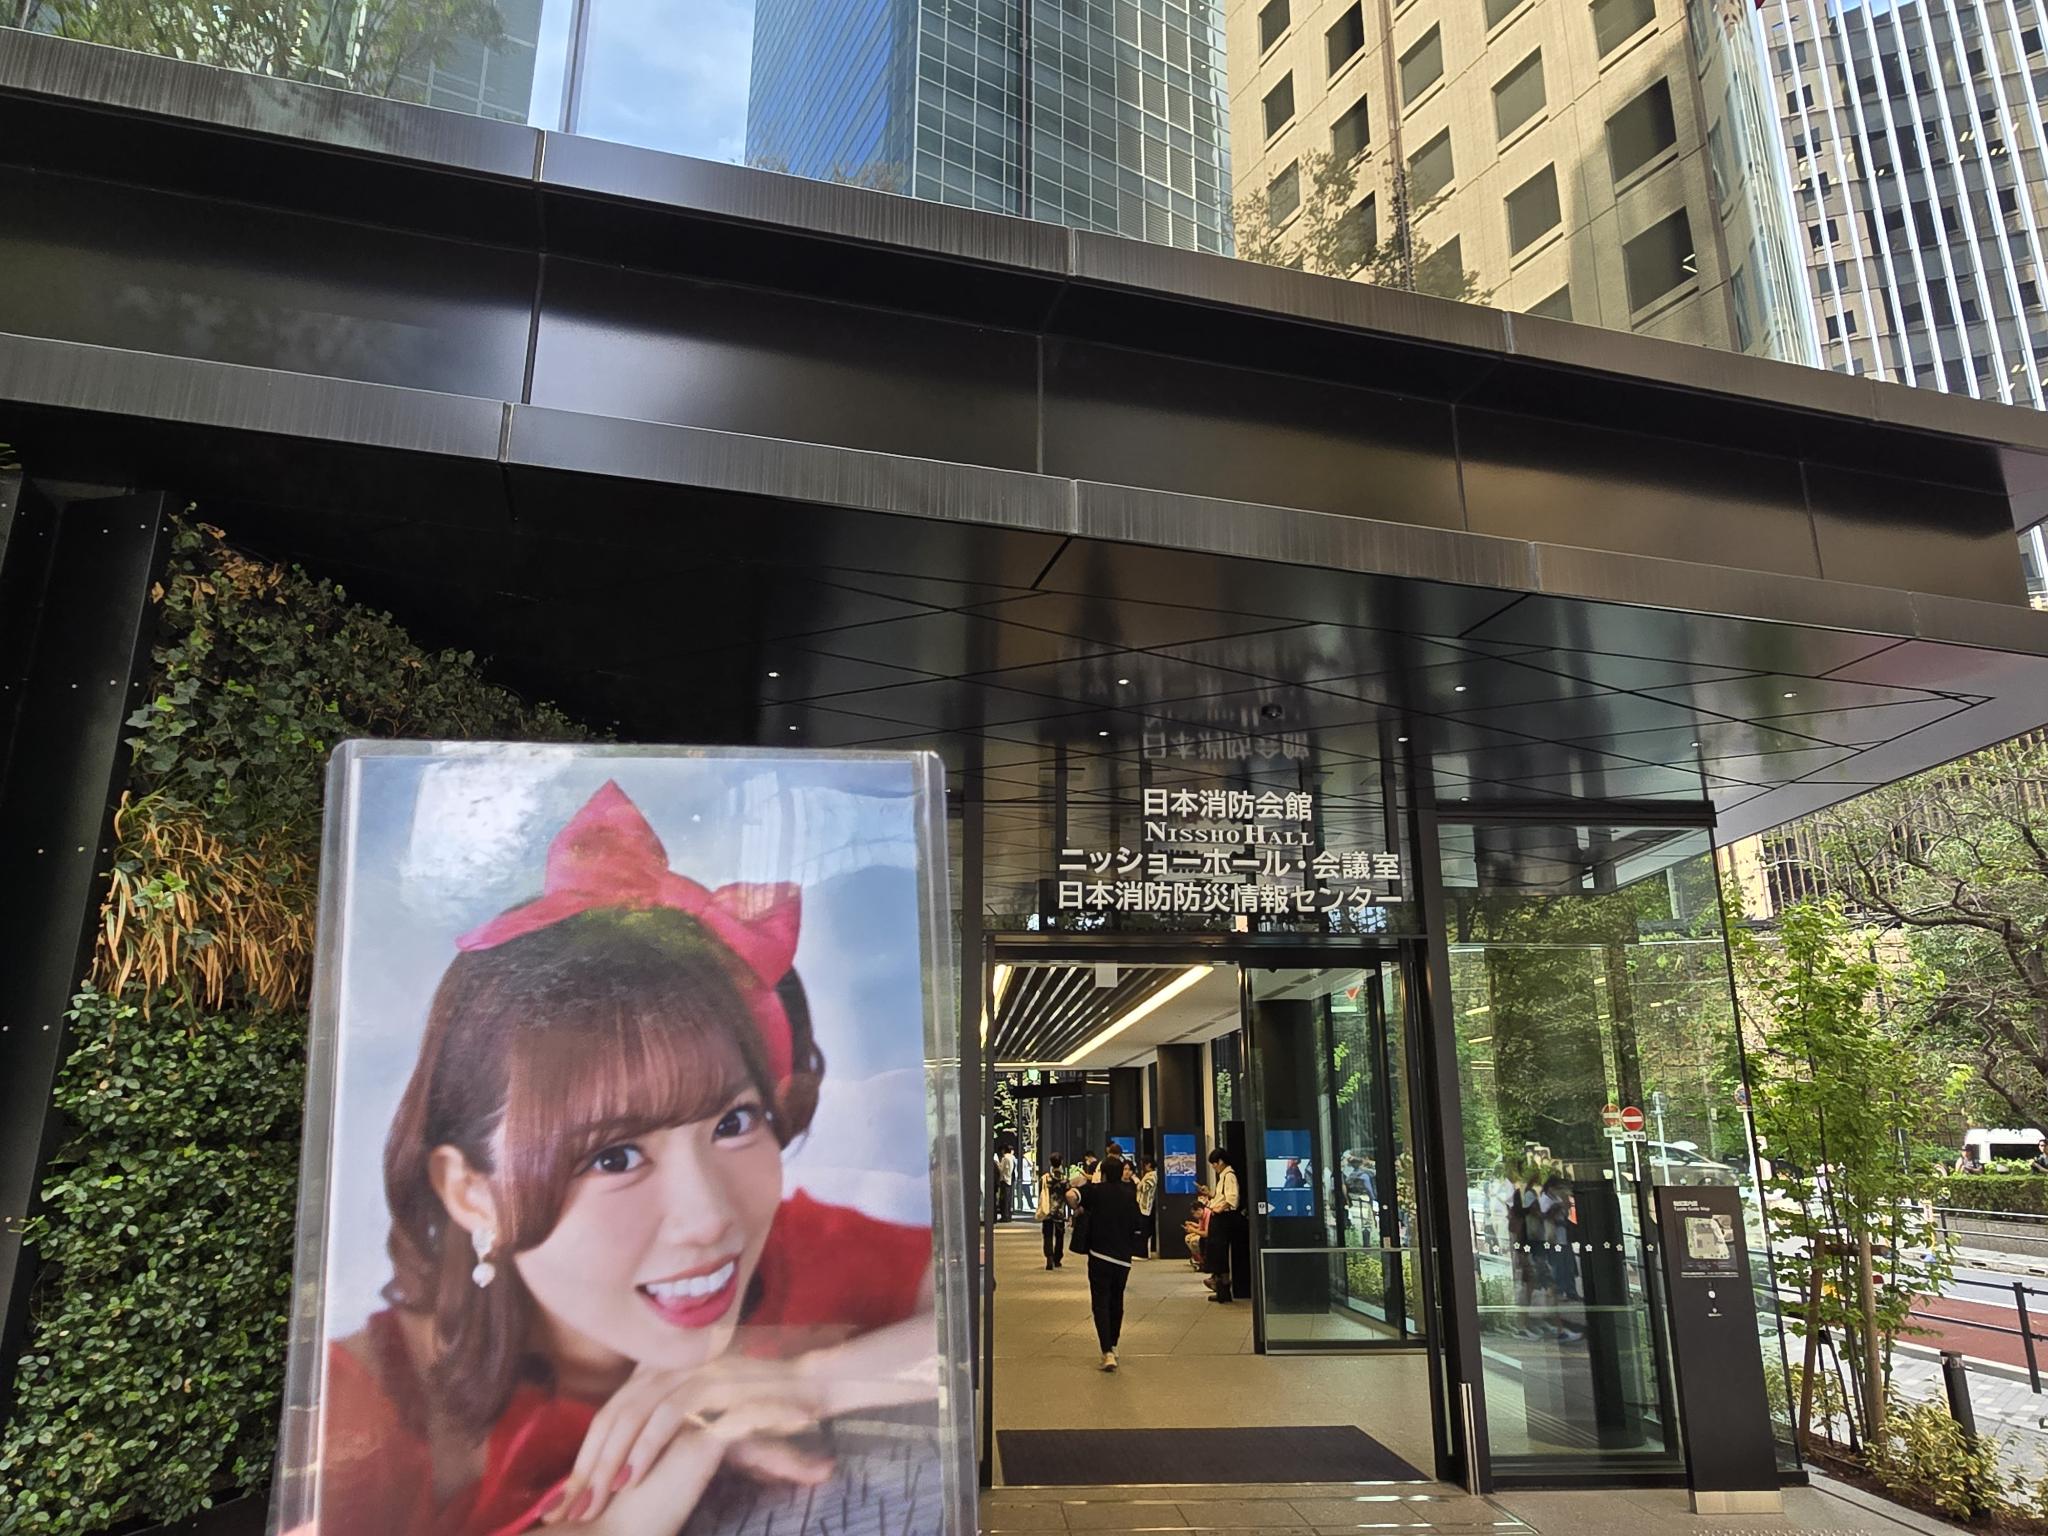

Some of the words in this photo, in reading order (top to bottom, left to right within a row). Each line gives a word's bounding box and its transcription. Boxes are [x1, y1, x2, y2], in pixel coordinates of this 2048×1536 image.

[1143, 788, 1313, 821] 日本消防会館
[1144, 821, 1240, 844] NISSHO
[1244, 825, 1314, 846] HALL
[1059, 848, 1401, 880] ニッショーホール・会議室
[1057, 881, 1403, 914] 日本消防防災情報センター
